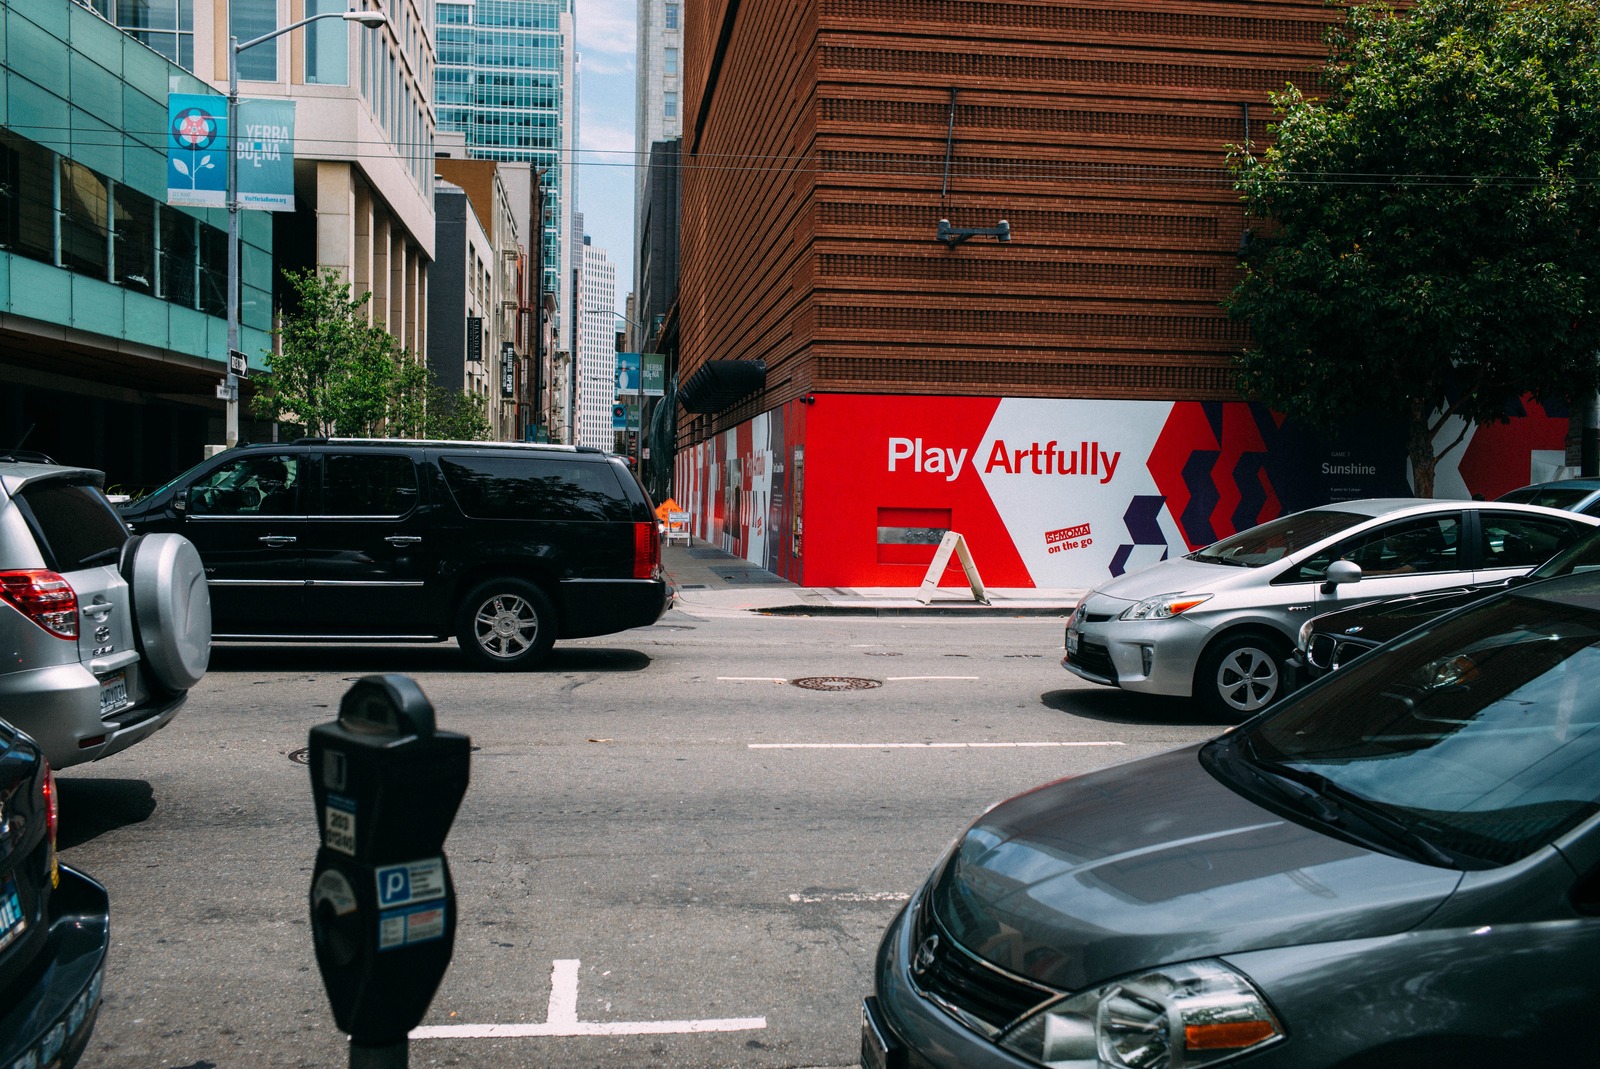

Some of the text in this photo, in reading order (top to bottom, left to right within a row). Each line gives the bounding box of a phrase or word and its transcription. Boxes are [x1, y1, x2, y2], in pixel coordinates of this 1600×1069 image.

[245, 124, 290, 144] YERBA
[236, 141, 281, 168] BUENA
[643, 370, 660, 380] BUENA
[646, 364, 662, 372] YERBA
[888, 437, 1121, 484] Play Artfully
[1322, 462, 1376, 475] Sunshine
[1046, 525, 1090, 543] SFMOMA
[1048, 538, 1093, 554] on the go
